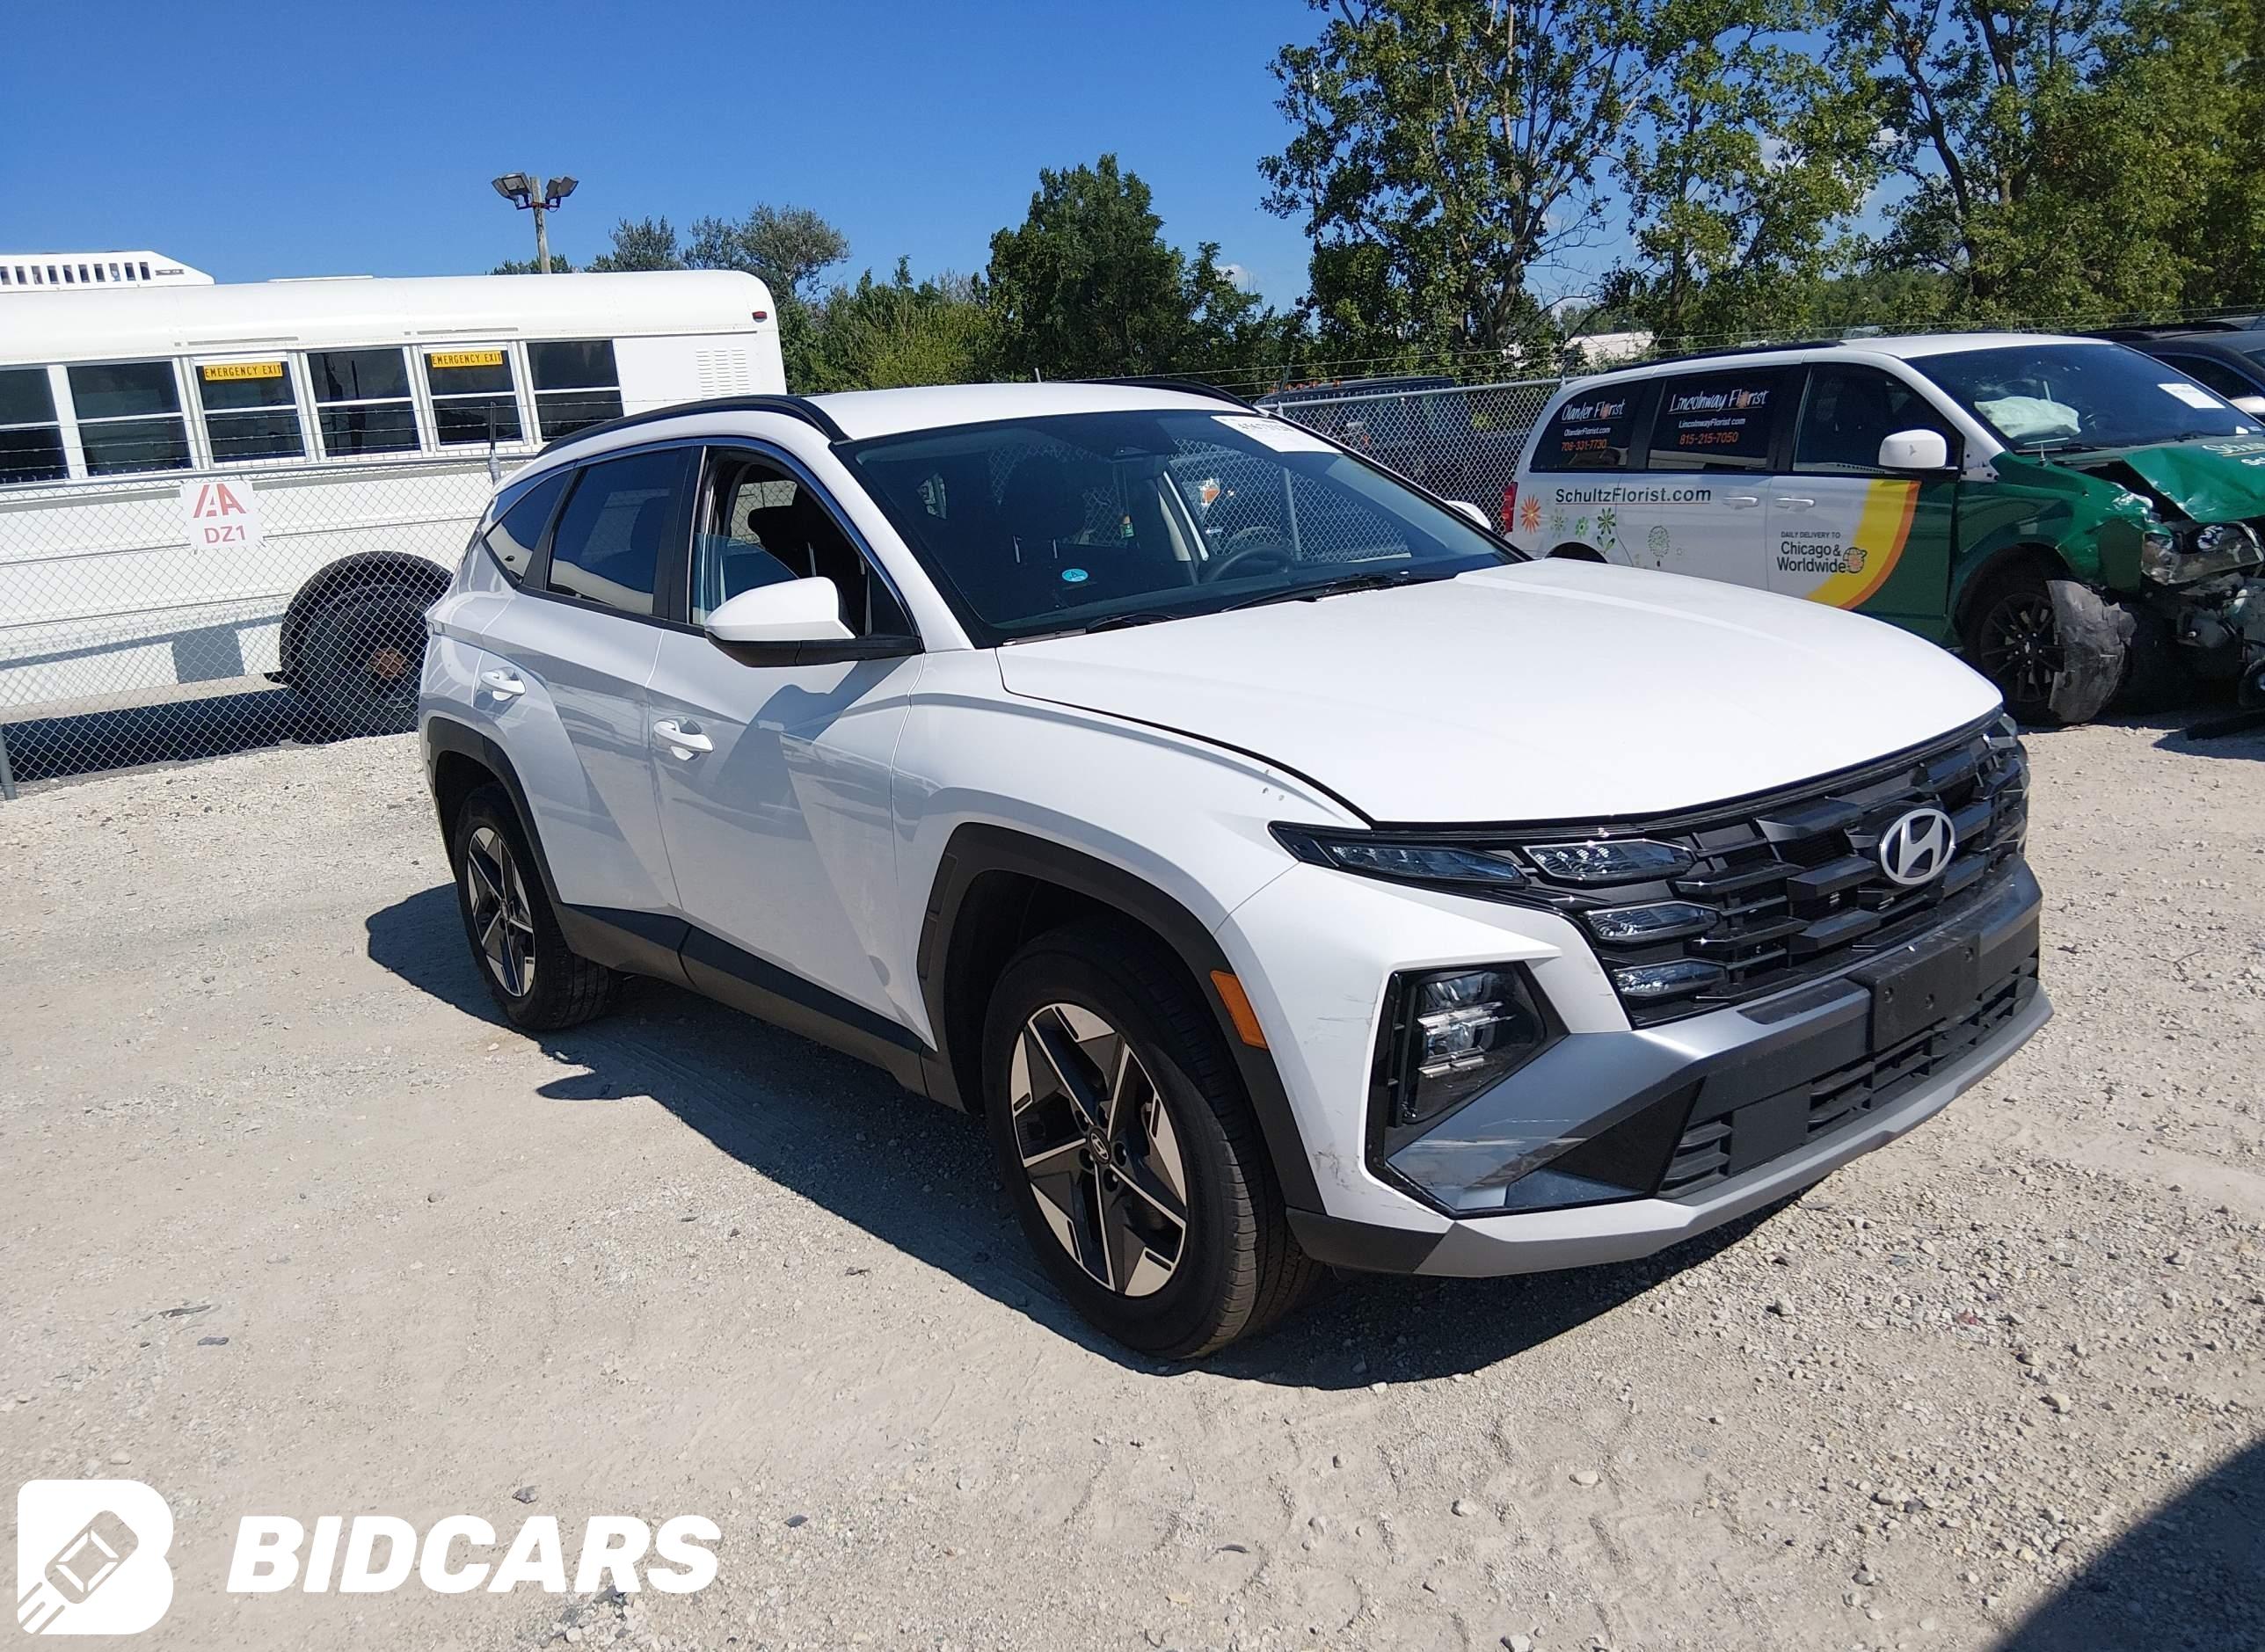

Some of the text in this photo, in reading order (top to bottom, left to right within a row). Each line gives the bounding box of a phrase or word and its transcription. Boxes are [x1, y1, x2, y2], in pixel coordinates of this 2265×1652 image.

[432, 353, 501, 365] EMERGENCY EXIT
[205, 365, 281, 378] EMERGENCY EXIT
[1669, 390, 1728, 411] Lincolnway
[1562, 402, 1593, 421] Olander
[1679, 432, 1739, 445] 815-215-7050
[1555, 487, 1711, 503] SchultzFlorist.com
[204, 525, 245, 544] DZ1
[1781, 541, 1841, 558] Chicago &
[1776, 557, 1846, 573] Worldwide
